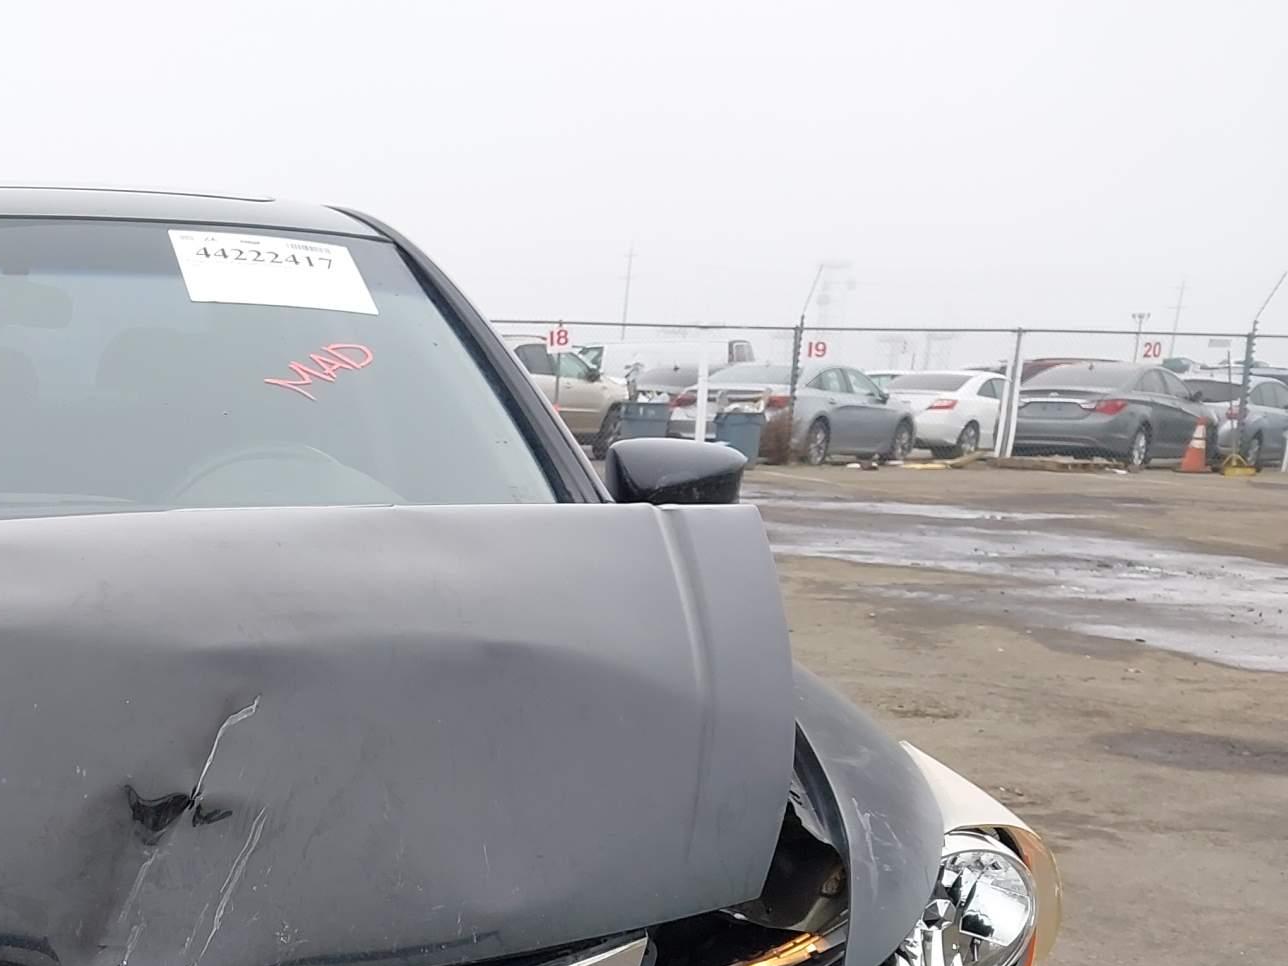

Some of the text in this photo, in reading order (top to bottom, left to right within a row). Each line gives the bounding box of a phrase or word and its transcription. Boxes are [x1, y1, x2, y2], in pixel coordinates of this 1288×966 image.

[195, 246, 333, 270] 44222417
[549, 329, 569, 345] 18
[808, 342, 827, 357] 19
[1143, 341, 1162, 358] 20
[263, 342, 375, 402] MAD
